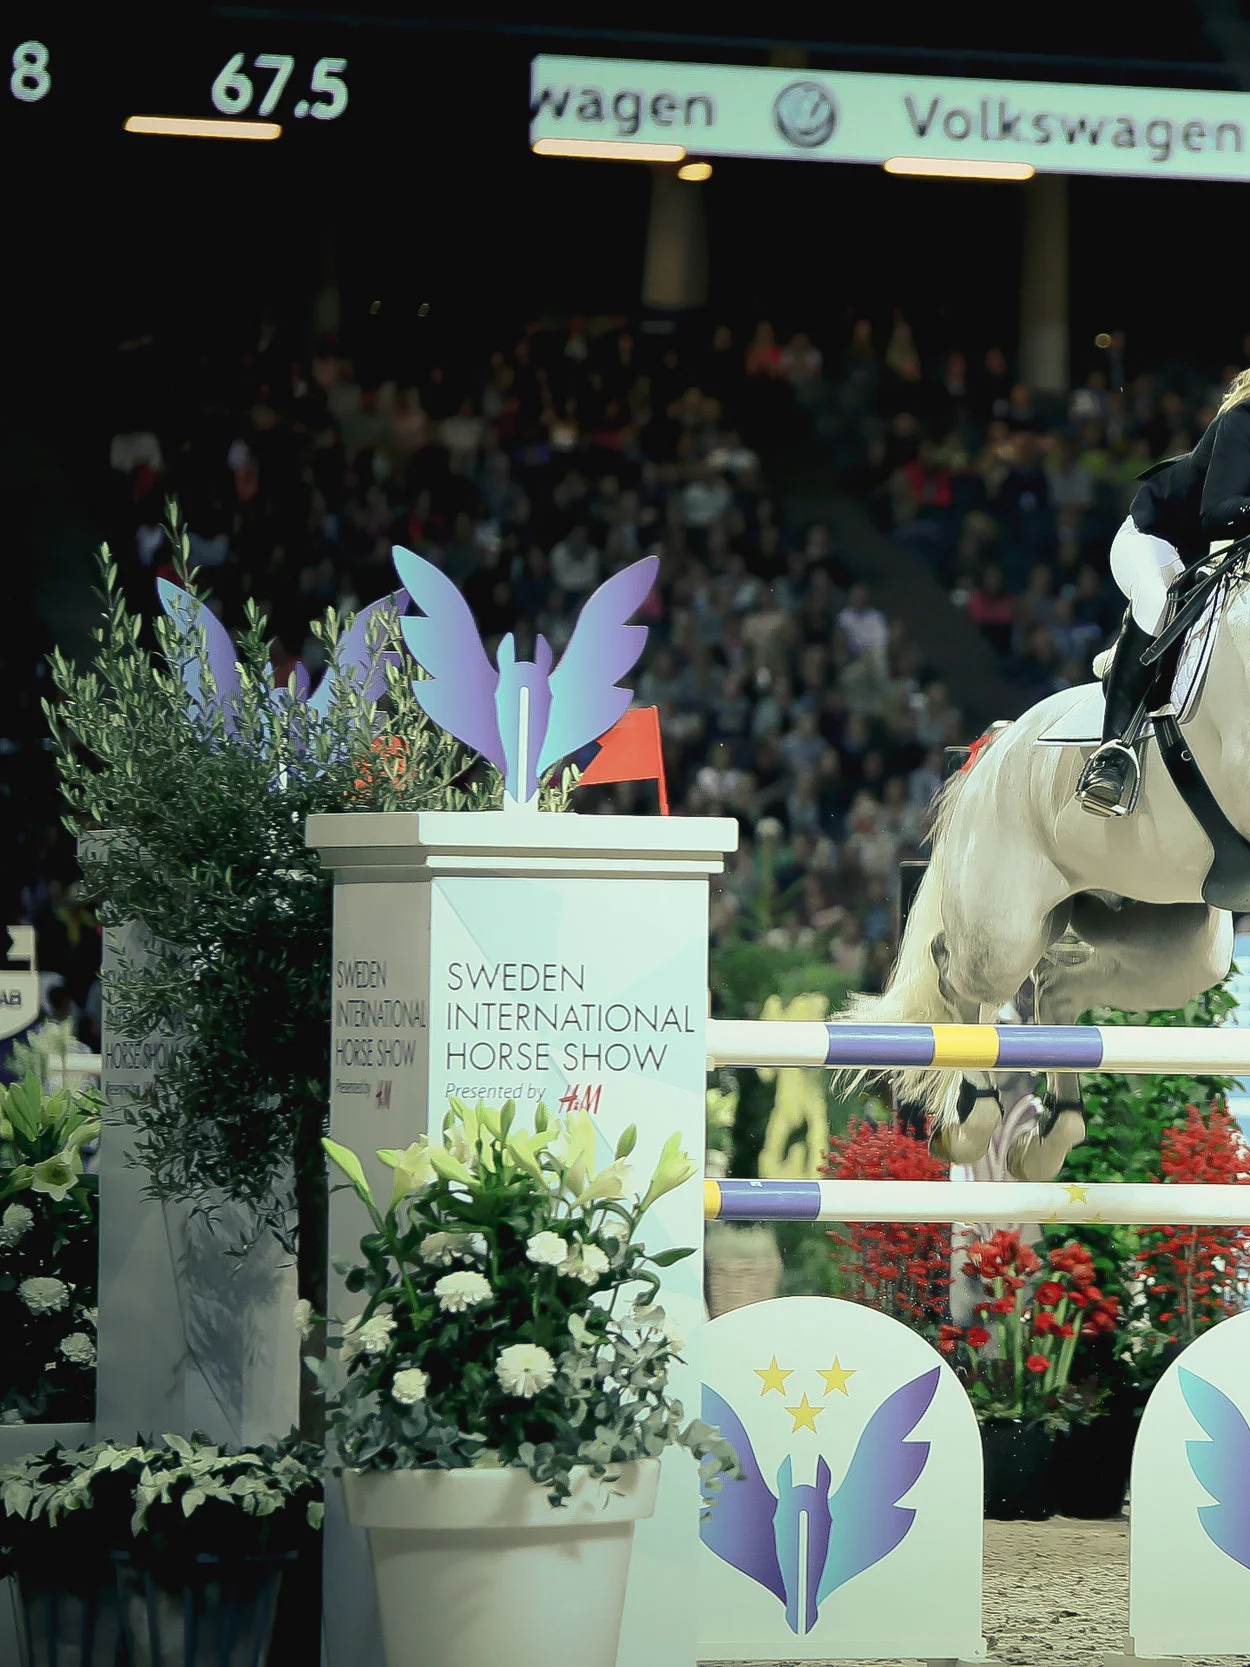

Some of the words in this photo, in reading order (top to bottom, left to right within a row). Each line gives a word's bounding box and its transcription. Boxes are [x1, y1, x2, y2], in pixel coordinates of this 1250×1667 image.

[10, 40, 50, 102] 8
[211, 53, 348, 120] 67.5
[903, 95, 1244, 162] Volkswagen
[337, 960, 387, 988] SWEDEN
[447, 962, 584, 992] SWEDEN
[446, 1002, 695, 1033] INTERNATIONAL
[445, 1041, 550, 1072] HORSE
[563, 1043, 668, 1072] SHOW
[445, 1083, 525, 1099] Presented
[527, 1083, 547, 1102] by
[558, 1083, 603, 1115] H&M
